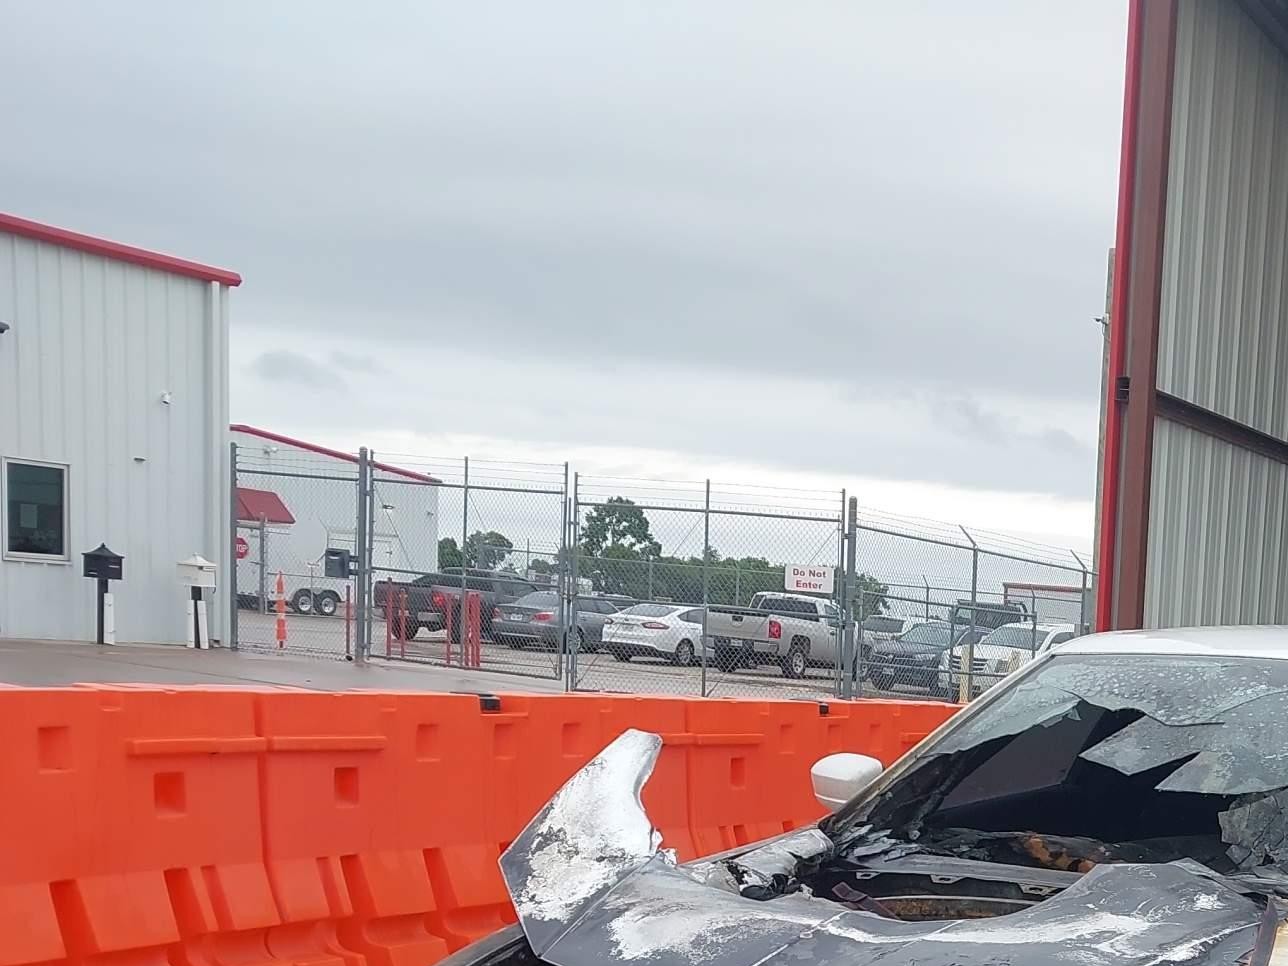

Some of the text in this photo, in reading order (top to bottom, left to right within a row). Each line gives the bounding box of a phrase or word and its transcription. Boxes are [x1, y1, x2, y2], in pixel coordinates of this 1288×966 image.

[792, 568, 826, 578] Do Not
[796, 580, 823, 589] Enter
